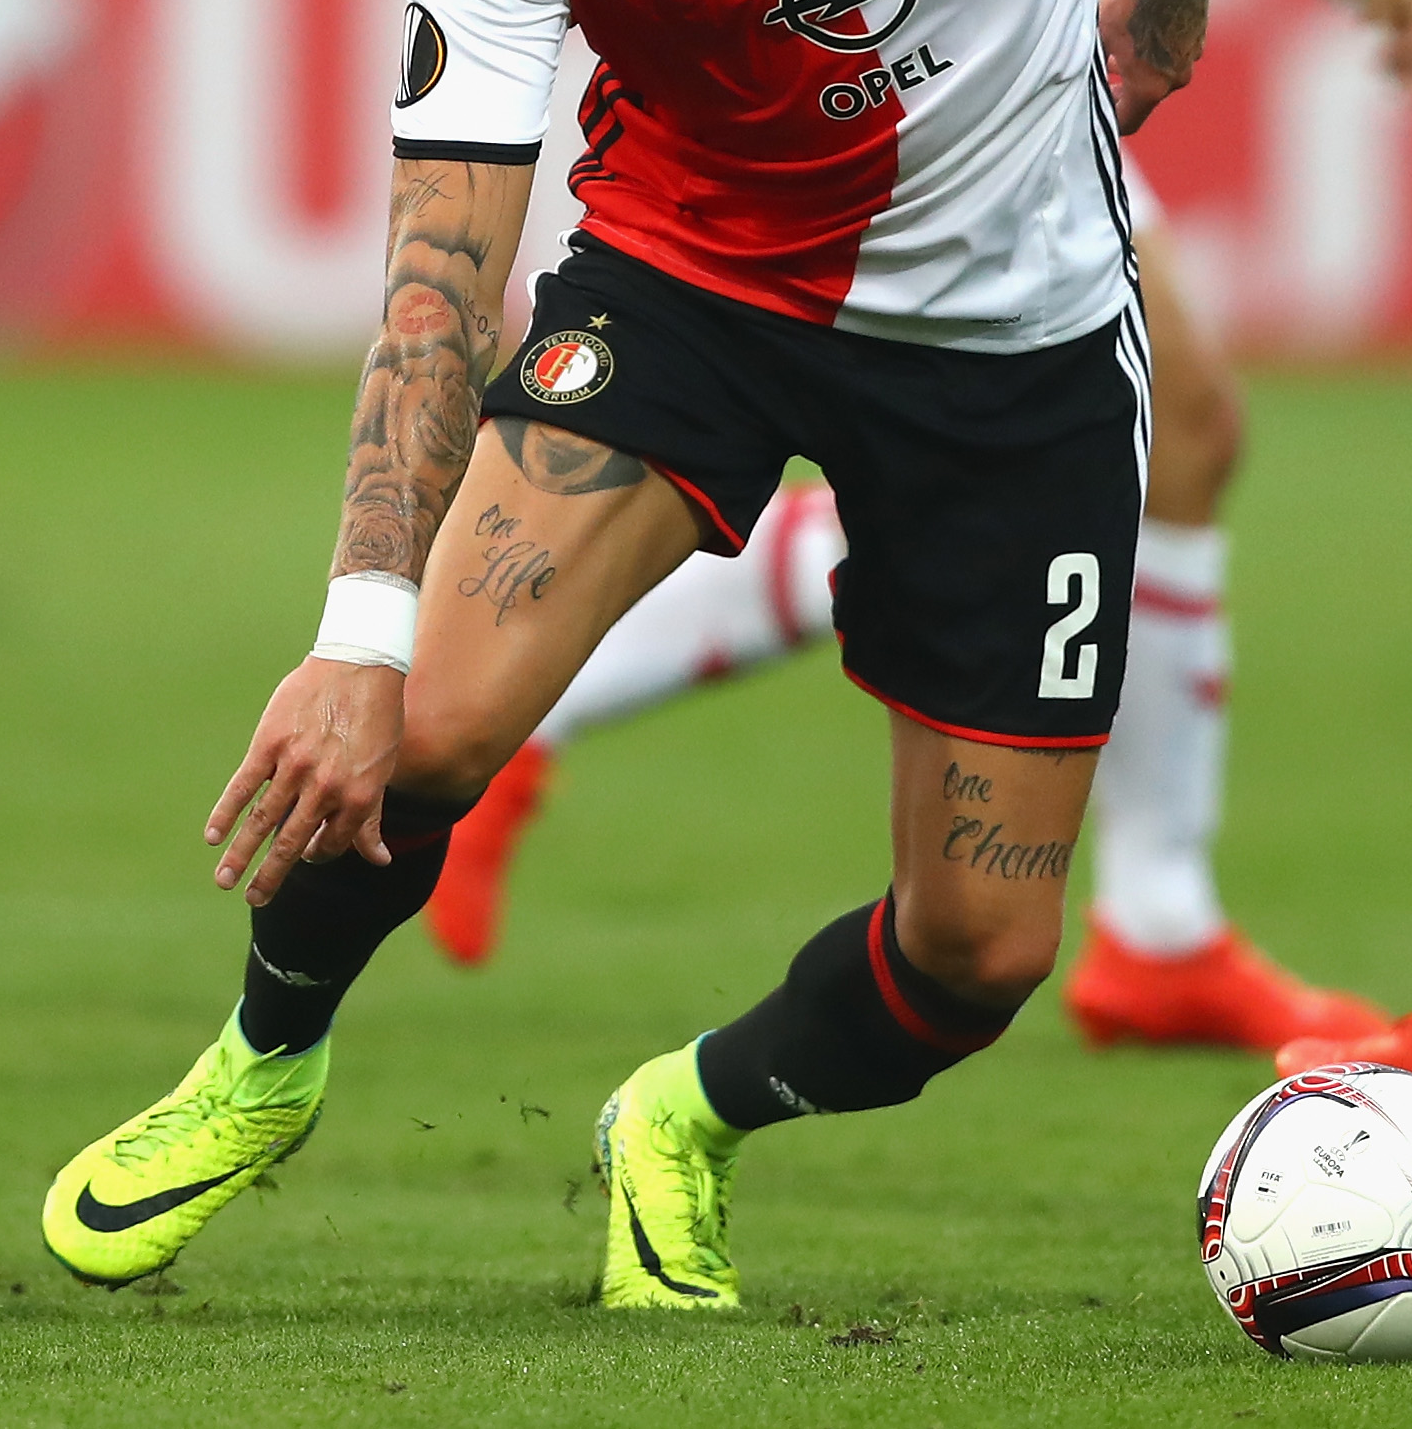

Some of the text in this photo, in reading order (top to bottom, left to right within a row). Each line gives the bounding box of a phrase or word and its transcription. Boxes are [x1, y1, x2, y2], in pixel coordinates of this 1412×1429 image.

[819, 43, 957, 121] OPEL
[544, 333, 609, 368] FEYENOORD
[524, 368, 591, 402] ROTTERDAM
[458, 541, 556, 627] Life
[1038, 552, 1101, 699] 2
[943, 761, 993, 803] One
[1313, 1145, 1345, 1179] EUROPA
